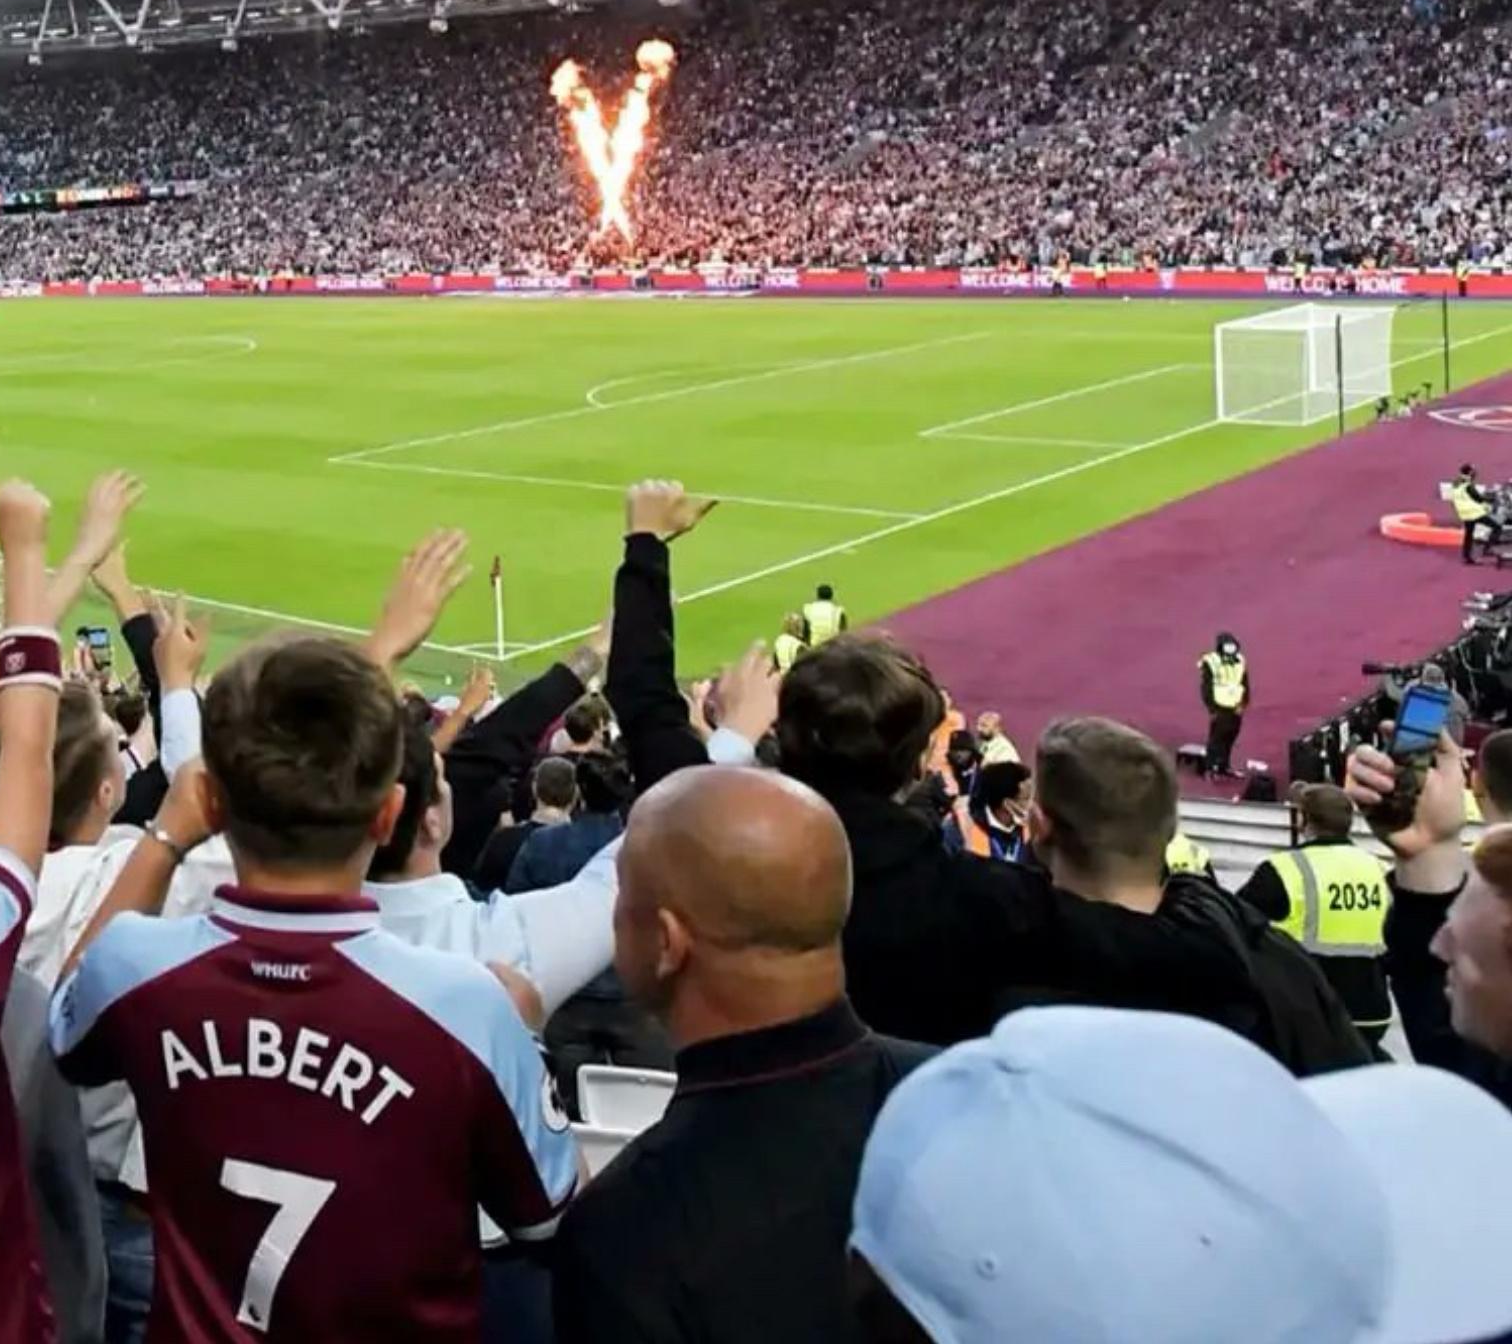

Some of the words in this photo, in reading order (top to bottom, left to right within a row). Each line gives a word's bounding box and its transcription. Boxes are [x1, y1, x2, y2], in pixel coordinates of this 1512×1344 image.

[1328, 882, 1381, 911] 2034
[250, 960, 313, 982] WHUFC
[161, 1015, 416, 1126] ALBERT
[219, 1157, 338, 1333] 7
